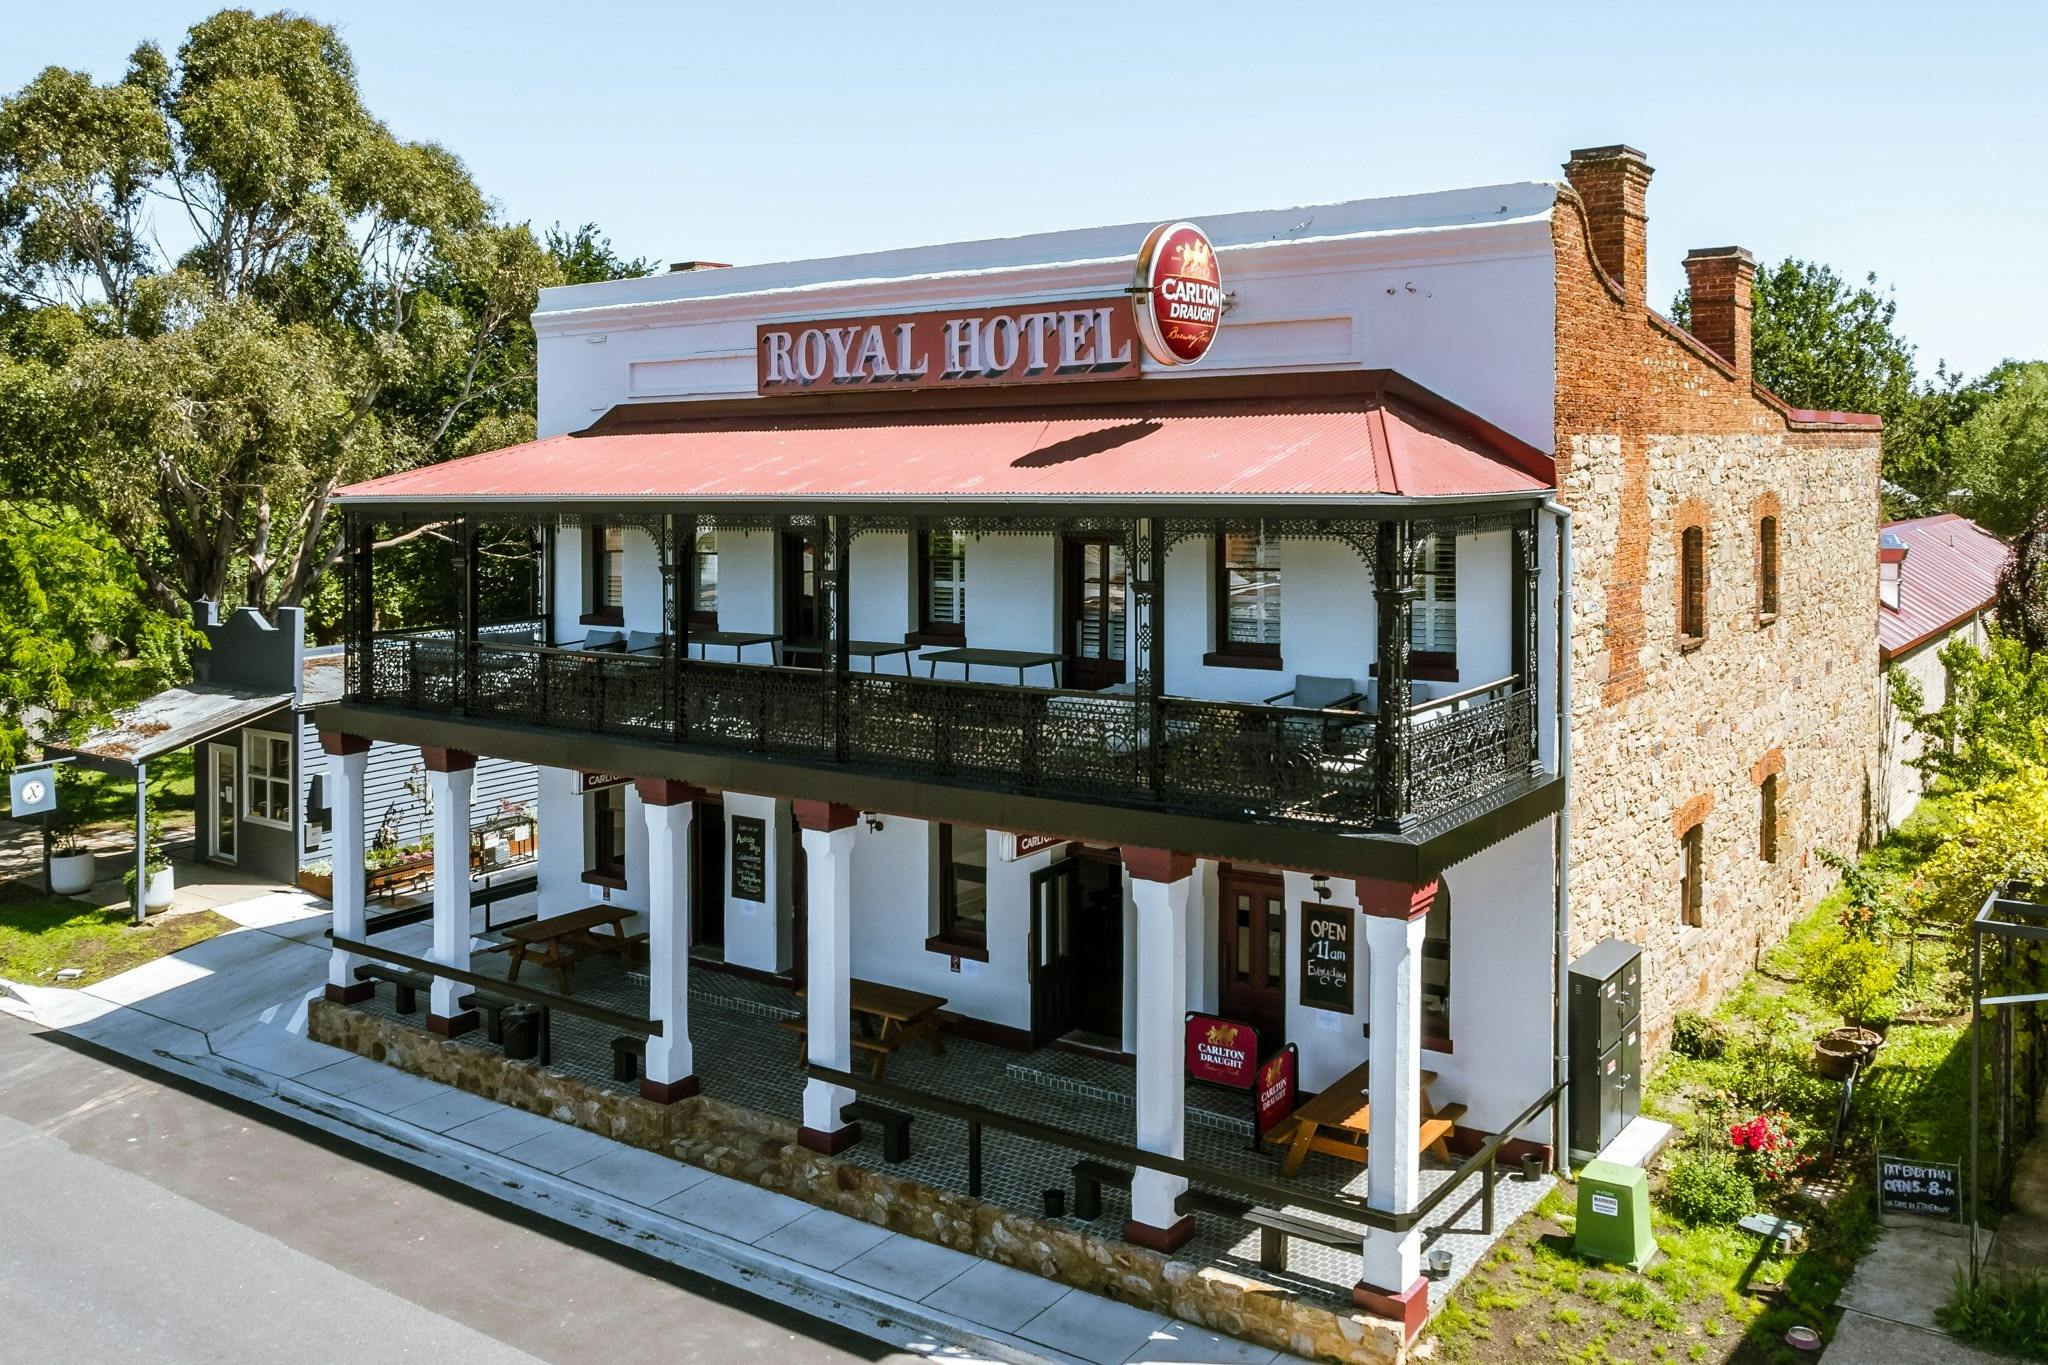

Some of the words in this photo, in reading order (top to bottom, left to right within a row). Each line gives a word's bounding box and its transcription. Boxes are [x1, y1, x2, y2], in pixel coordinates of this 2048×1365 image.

[1161, 278, 1220, 307] CARLTON
[1170, 302, 1215, 322] DRAUGHT
[763, 322, 929, 385] ROYAL
[941, 307, 1131, 379] HOTEL
[1310, 919, 1347, 941] OPEN
[1307, 959, 1347, 987] Everyday
[1198, 1042, 1245, 1060] CARLTON
[1200, 1053, 1244, 1069] DRAUGHT
[1261, 1077, 1288, 1103] CARLTON
[1262, 1088, 1287, 1112] DRAUGHT
[1884, 1179, 1912, 1193] OPEN
